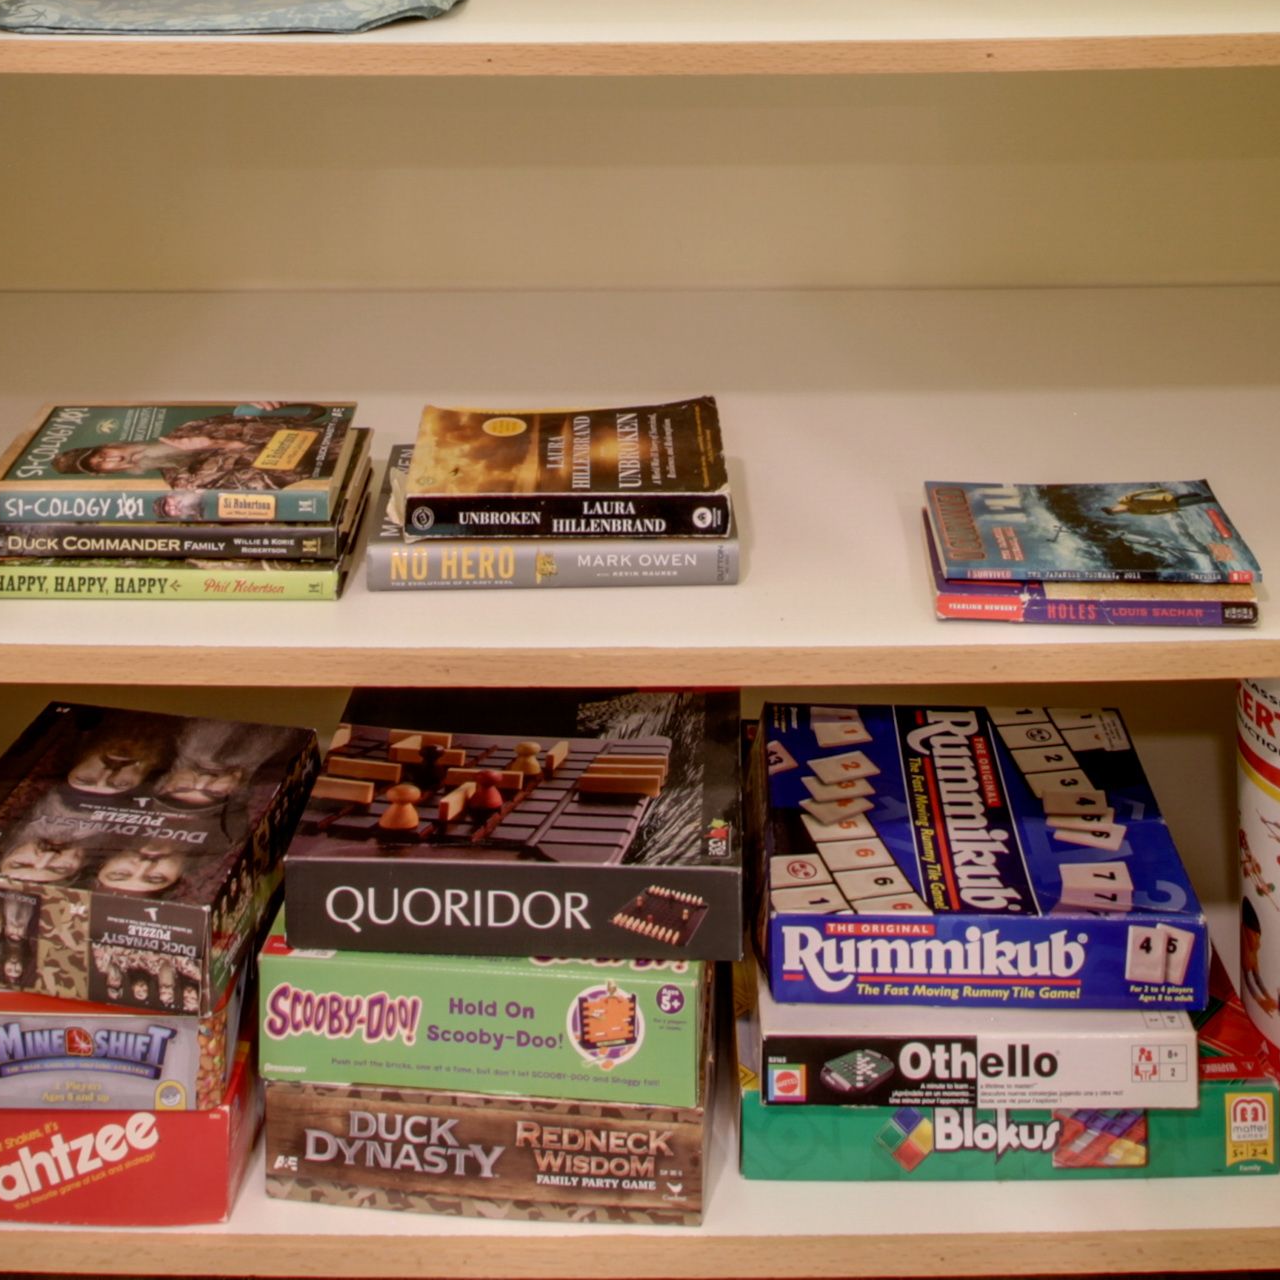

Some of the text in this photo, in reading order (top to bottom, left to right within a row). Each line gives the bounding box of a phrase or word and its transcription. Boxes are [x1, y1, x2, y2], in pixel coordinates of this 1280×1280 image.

[546, 435, 566, 469] LAURA
[572, 415, 591, 489] HILLENBRAND
[616, 413, 643, 489] UNBROKEN
[5, 498, 111, 517] SI-COLOGY
[582, 501, 636, 515] LAURA
[458, 511, 542, 525] UNBROKEN
[552, 519, 667, 533] HILLENBRAND
[7, 536, 60, 551] DUCK
[62, 536, 181, 551] COMMANDER
[183, 540, 226, 551] FAMILY
[391, 546, 516, 581] NO HERO
[577, 554, 697, 567] MARK OWEN
[54, 576, 110, 595] HAPPY,
[114, 577, 168, 594] HAPPY
[203, 578, 285, 594] Phil Robertson
[1047, 603, 1097, 620] HOLES
[1112, 607, 1204, 617] LOUIS SACHAR
[908, 758, 922, 772] The
[973, 738, 999, 804] THE ORIGINAL
[913, 775, 925, 795] Fast
[91, 810, 165, 827] PUZZLE
[907, 710, 1022, 909] Rummikub
[915, 794, 930, 827] Moving
[142, 827, 208, 844] DUCK
[921, 828, 935, 863] Rummy
[927, 864, 942, 882] Tile
[324, 884, 591, 933] QUORIDOR
[128, 925, 172, 940] PUZZLE
[827, 923, 929, 934] THE ORIGINAL
[101, 932, 197, 956] DUCK DYNASTY
[1139, 936, 1153, 954] 4
[782, 926, 1085, 993] Rummikub
[660, 987, 680, 998] Ages
[856, 984, 1080, 1001] The Fast Moving Rummy Tile Game!
[266, 982, 422, 1045] SCOOBY-DOO!
[449, 997, 535, 1020] Hold On
[660, 996, 681, 1011] 5+
[95, 1025, 176, 1065] SHIFT
[426, 1024, 564, 1051] Scooby-Doo!
[899, 1041, 1058, 1080] Othello
[4, 1128, 44, 1149] Shakes,
[348, 1110, 460, 1147] DUCK
[515, 1120, 674, 1156] REDNECK
[934, 1107, 1060, 1154] Blokus
[1232, 1124, 1268, 1133] mattel
[304, 1128, 506, 1178] DYNASTY
[1251, 1148, 1268, 1157] 2-4
[533, 1149, 656, 1178] WISDOM
[31, 1189, 58, 1205] favorite
[59, 1182, 81, 1196] game
[91, 1170, 107, 1182] luck
[108, 1164, 124, 1175] and
[535, 1174, 656, 1190] FAMILY PARTY GAME
